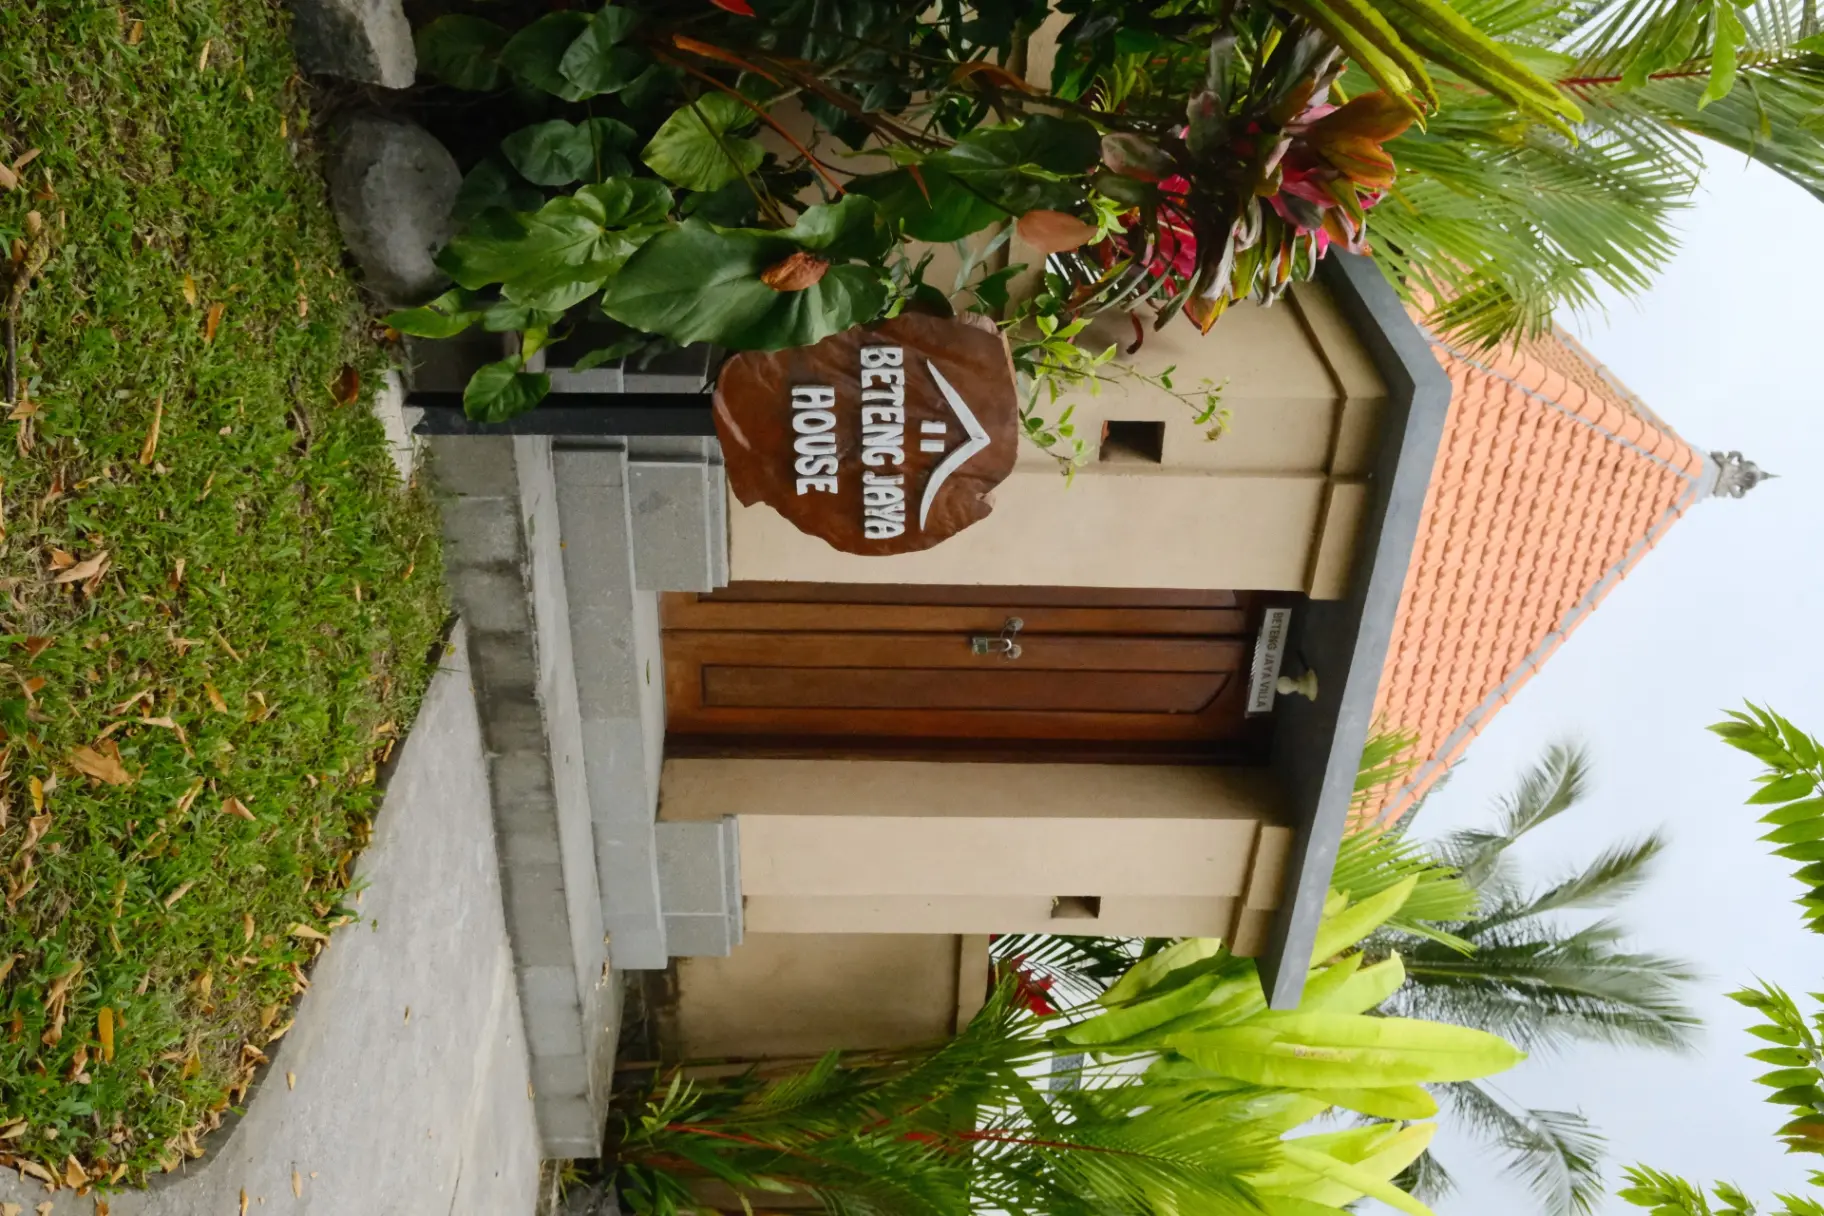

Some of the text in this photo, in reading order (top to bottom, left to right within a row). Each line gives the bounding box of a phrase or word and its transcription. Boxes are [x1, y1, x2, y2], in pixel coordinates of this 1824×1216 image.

[791, 386, 839, 495] HOUSE
[860, 347, 906, 540] BETENG JAYA
[1256, 612, 1284, 708] BETENG JAYA VILLA
